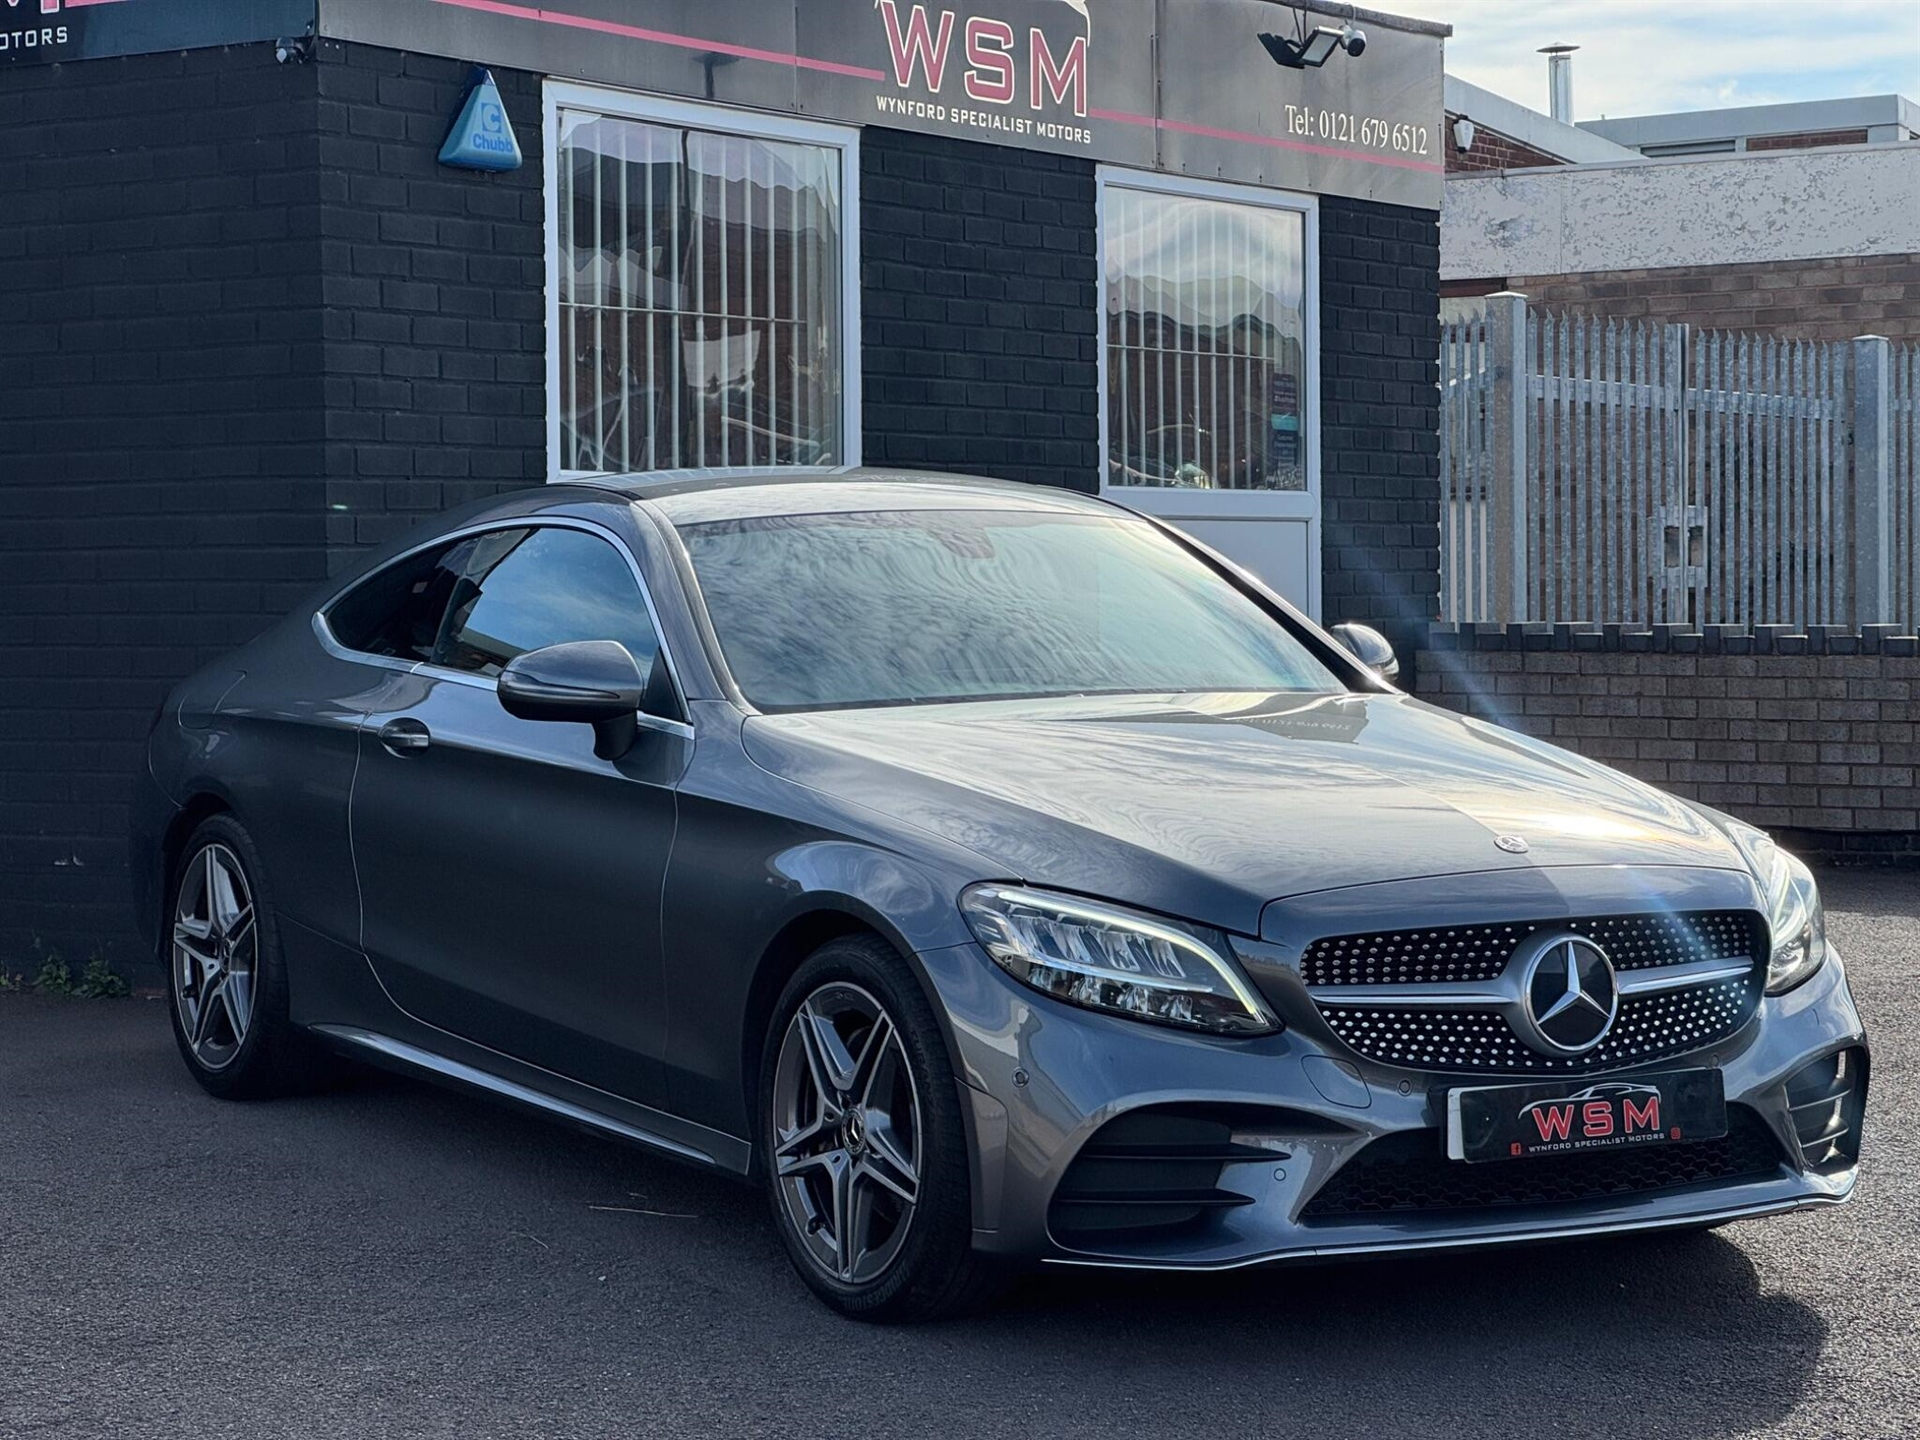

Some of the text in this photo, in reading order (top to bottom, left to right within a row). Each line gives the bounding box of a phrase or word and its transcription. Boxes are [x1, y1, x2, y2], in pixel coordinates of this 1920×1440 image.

[880, 0, 1087, 118] WSM
[472, 133, 513, 153] Chubb
[876, 95, 1091, 144] WYNFORD SPECIALIST MOTORS
[1285, 104, 1428, 155] Tel: 0121 679 6512
[1529, 1132, 1665, 1153] WYNFORD SPECIALIST MOTORS
[1531, 1096, 1660, 1142] WSM
